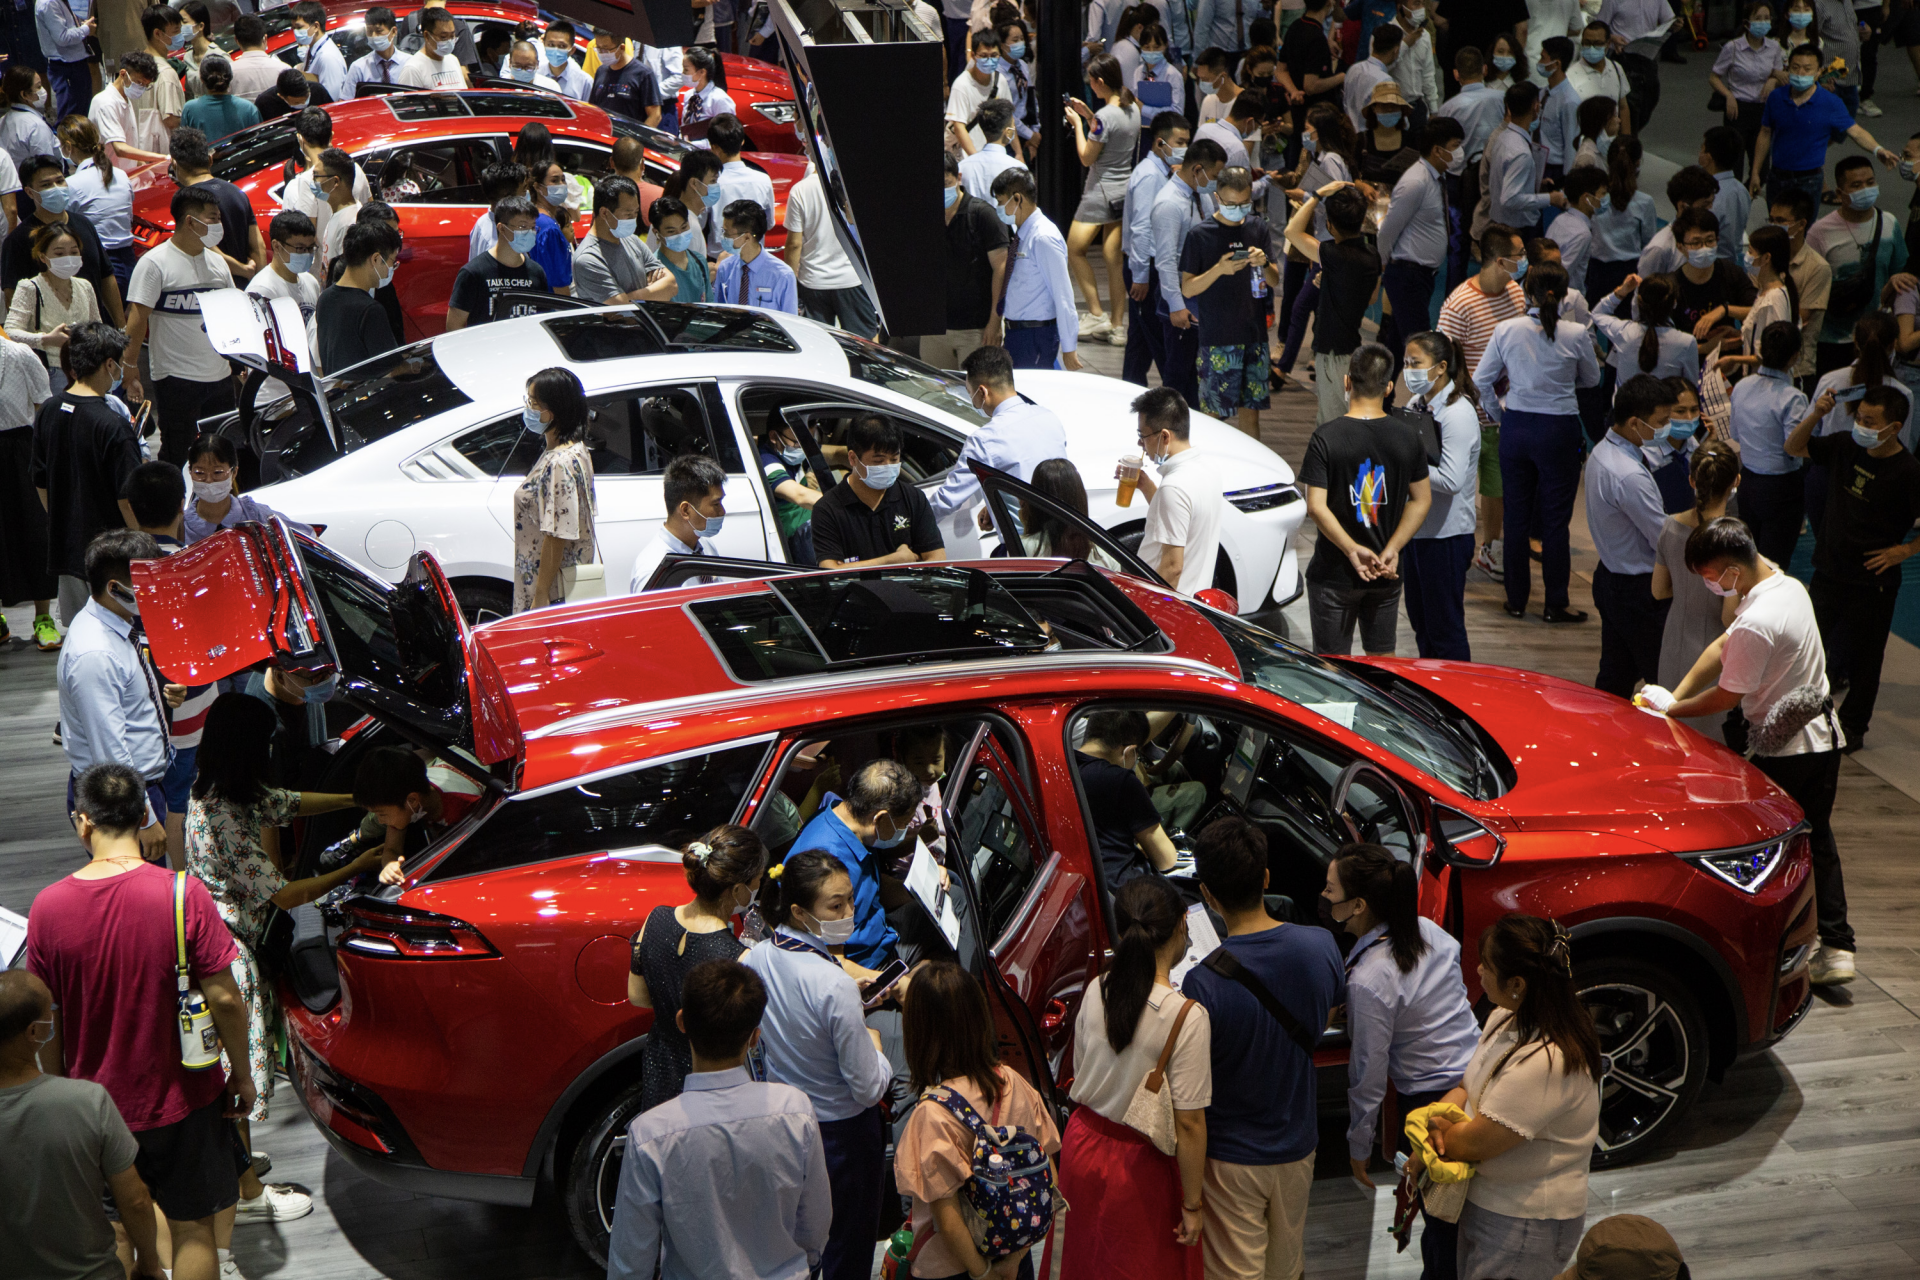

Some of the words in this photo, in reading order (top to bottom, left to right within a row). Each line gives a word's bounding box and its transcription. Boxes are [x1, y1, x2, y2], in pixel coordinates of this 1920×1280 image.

[486, 278, 504, 287] TALK
[504, 278, 511, 287] IS
[511, 278, 533, 288] CHEAP
